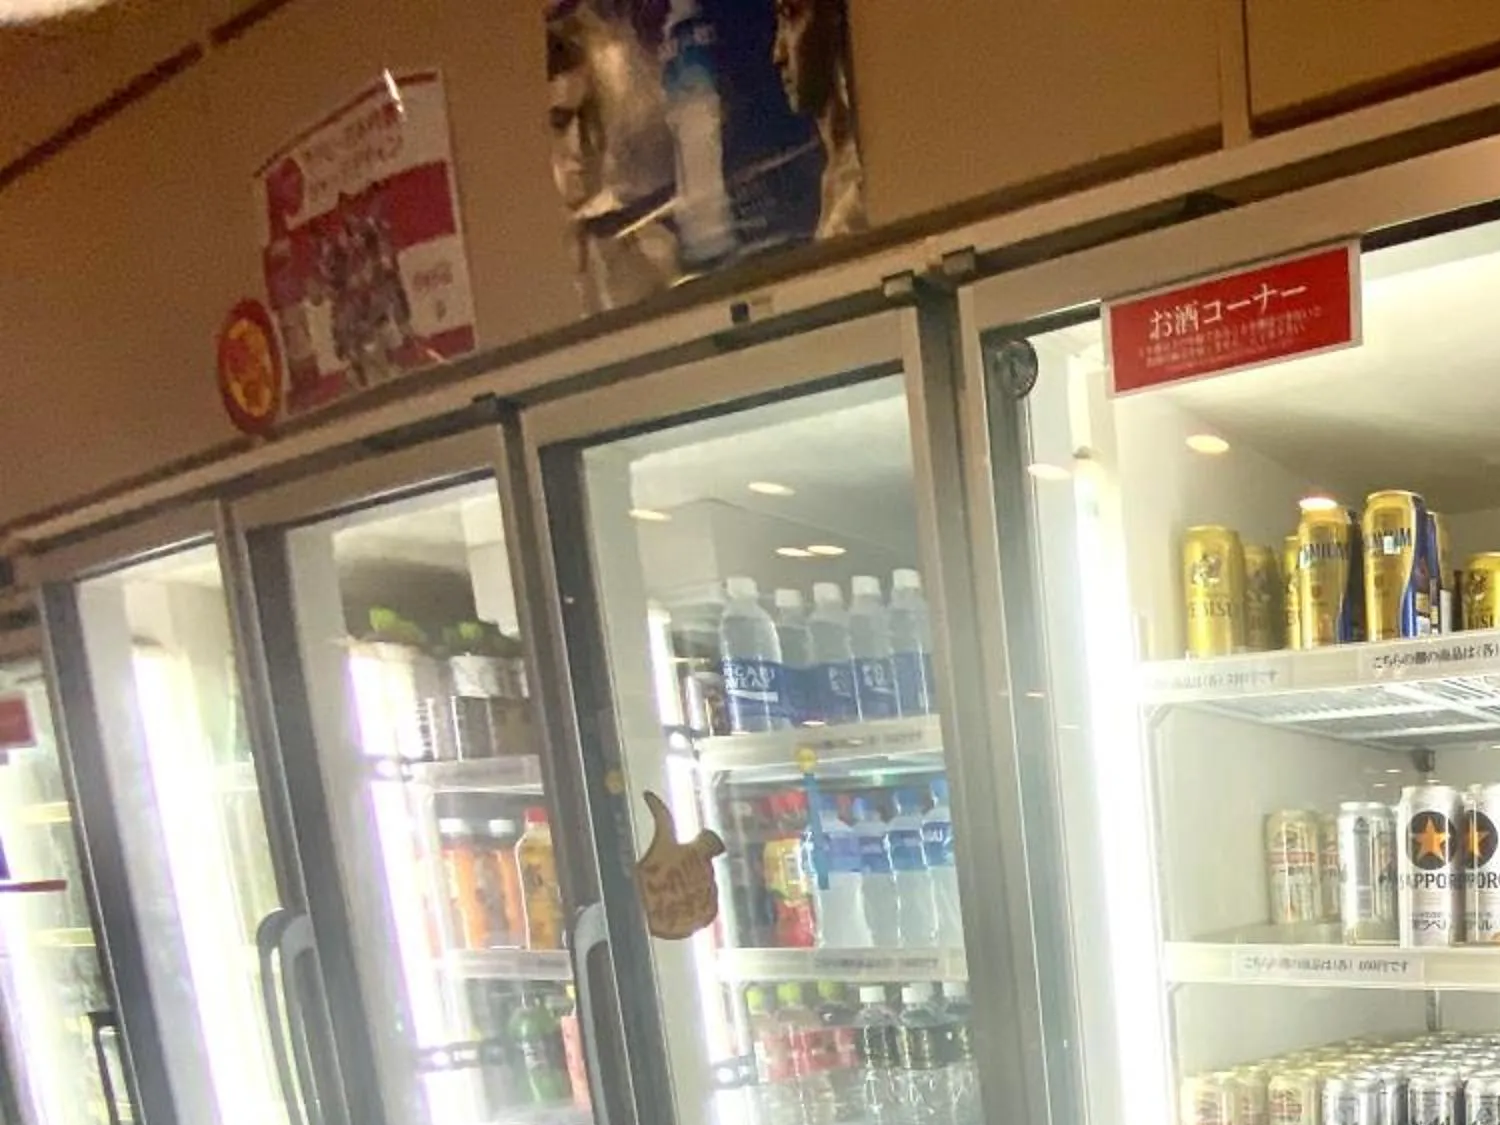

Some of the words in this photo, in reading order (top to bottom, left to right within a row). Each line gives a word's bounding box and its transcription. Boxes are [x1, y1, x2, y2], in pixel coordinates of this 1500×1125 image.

[1150, 283, 1307, 340] お酒コーナー
